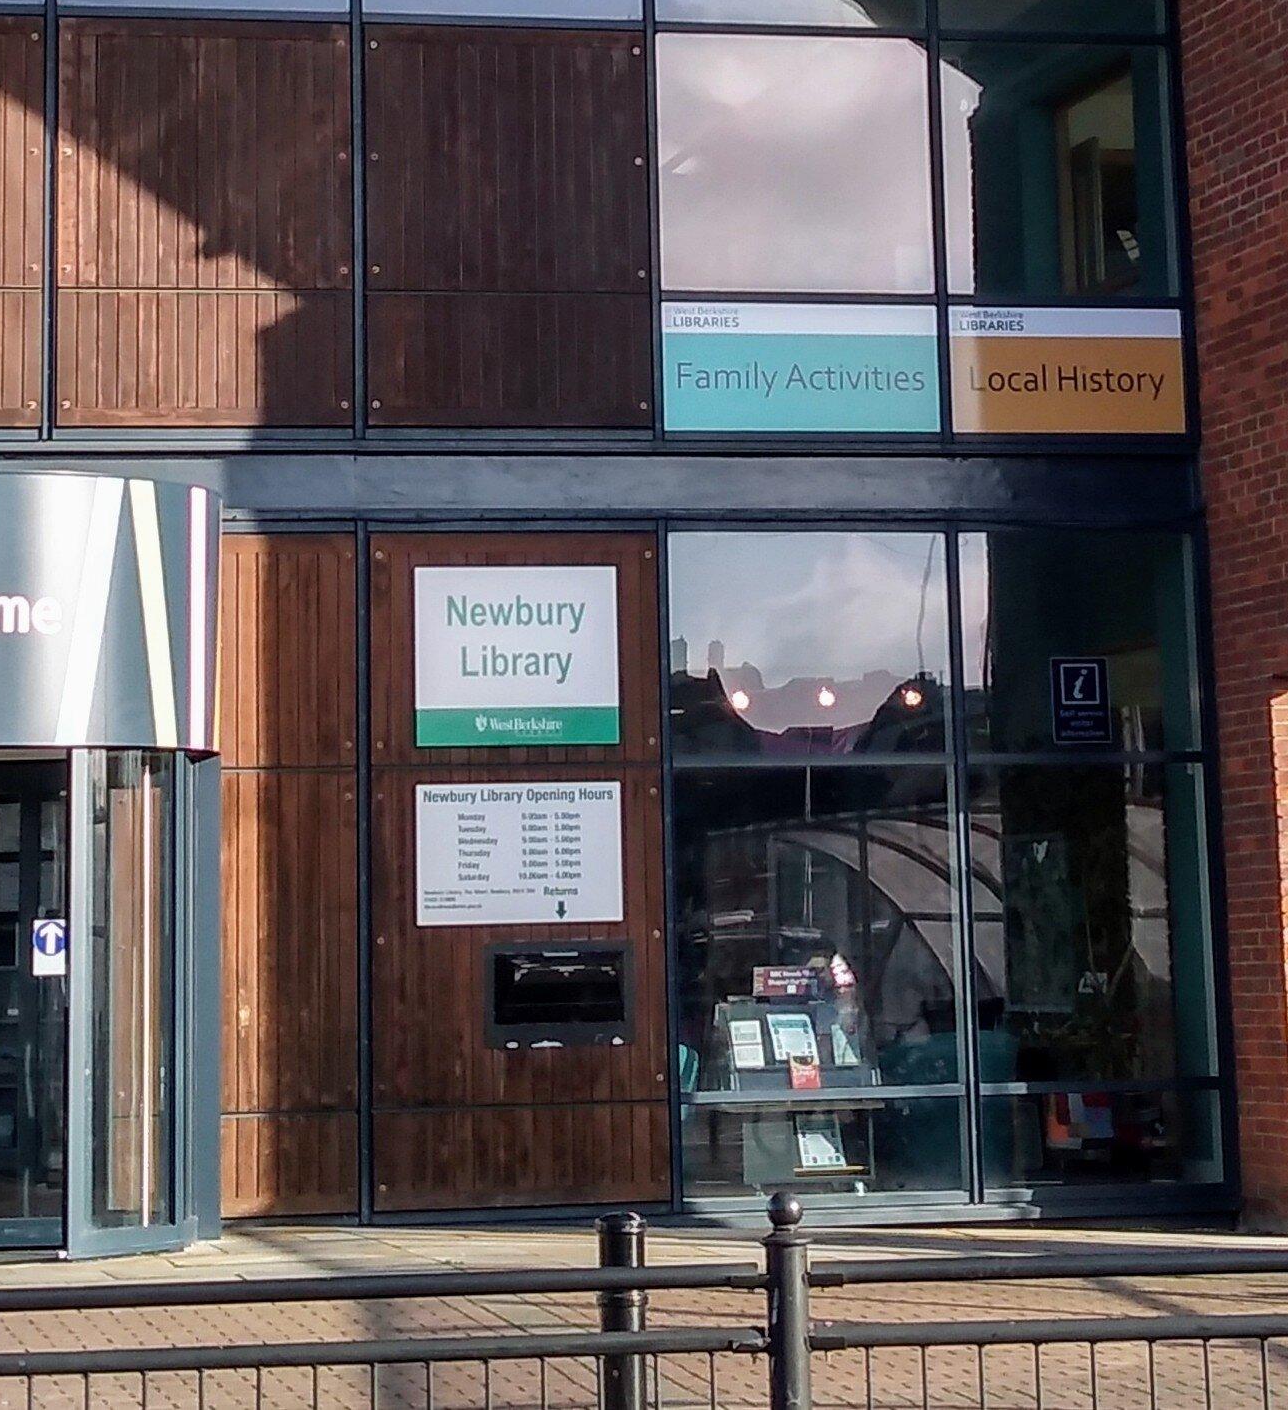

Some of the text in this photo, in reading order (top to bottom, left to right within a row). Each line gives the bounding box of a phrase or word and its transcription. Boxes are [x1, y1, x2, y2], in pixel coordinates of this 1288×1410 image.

[673, 316, 740, 328] LIBRARIES
[959, 319, 1025, 331] LIBRARIES
[676, 361, 925, 397] Family Activities
[969, 363, 1165, 401] Local History
[446, 594, 586, 634] Newbury
[461, 645, 573, 685] Library
[423, 788, 614, 805] Newbury Library Opening Hours
[457, 813, 485, 821] Monday
[458, 825, 486, 833] Tuesday
[458, 849, 491, 857] Thursday
[458, 861, 480, 869] Friday
[458, 873, 490, 881] Saturday
[543, 886, 578, 896] Returns
